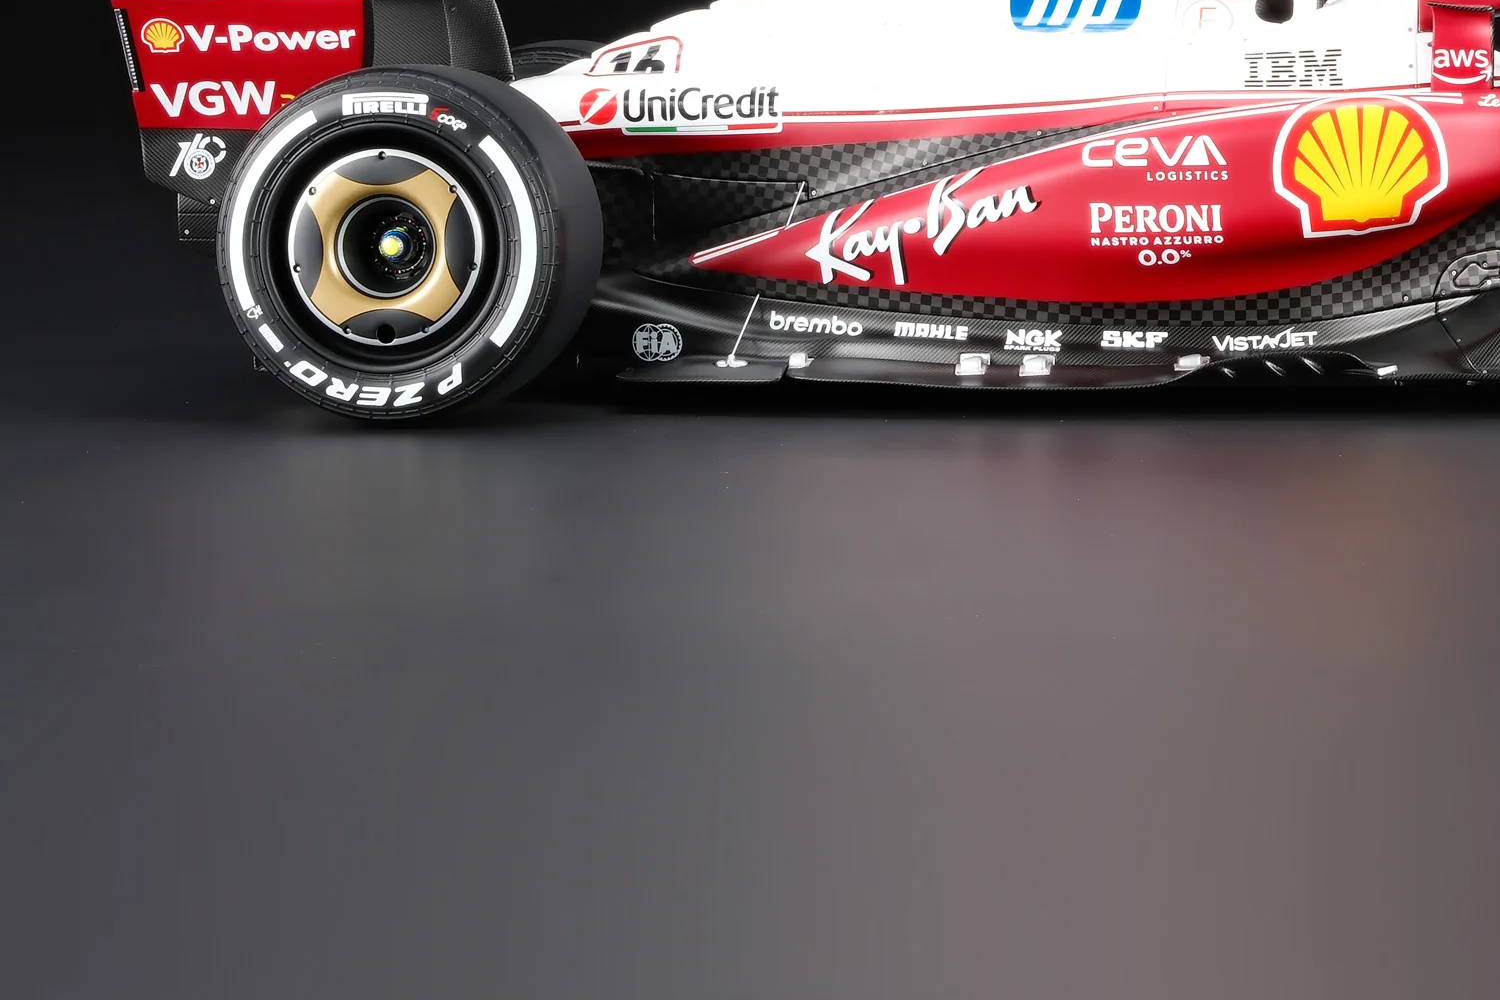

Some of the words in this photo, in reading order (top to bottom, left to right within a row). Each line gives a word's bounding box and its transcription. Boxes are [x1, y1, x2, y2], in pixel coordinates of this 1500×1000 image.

[184, 24, 356, 51] V-Power
[1244, 48, 1343, 88] IBM
[1433, 48, 1490, 69] aws
[150, 80, 276, 118] VGW
[342, 91, 430, 116] PIRELLI
[622, 86, 780, 123] UniCredit
[1146, 170, 1229, 182] LOGISTICS
[1089, 202, 1223, 234] PERONI
[1090, 236, 1150, 247] NASTRO
[1153, 235, 1224, 246] AZZURRO
[1137, 248, 1192, 267] 0.0%
[769, 310, 864, 336] brembo
[893, 321, 969, 341] MAHLE
[1005, 328, 1063, 347] NGK
[1100, 330, 1169, 348] SKF
[288, 359, 426, 407] ZERO
[437, 361, 463, 396] P
